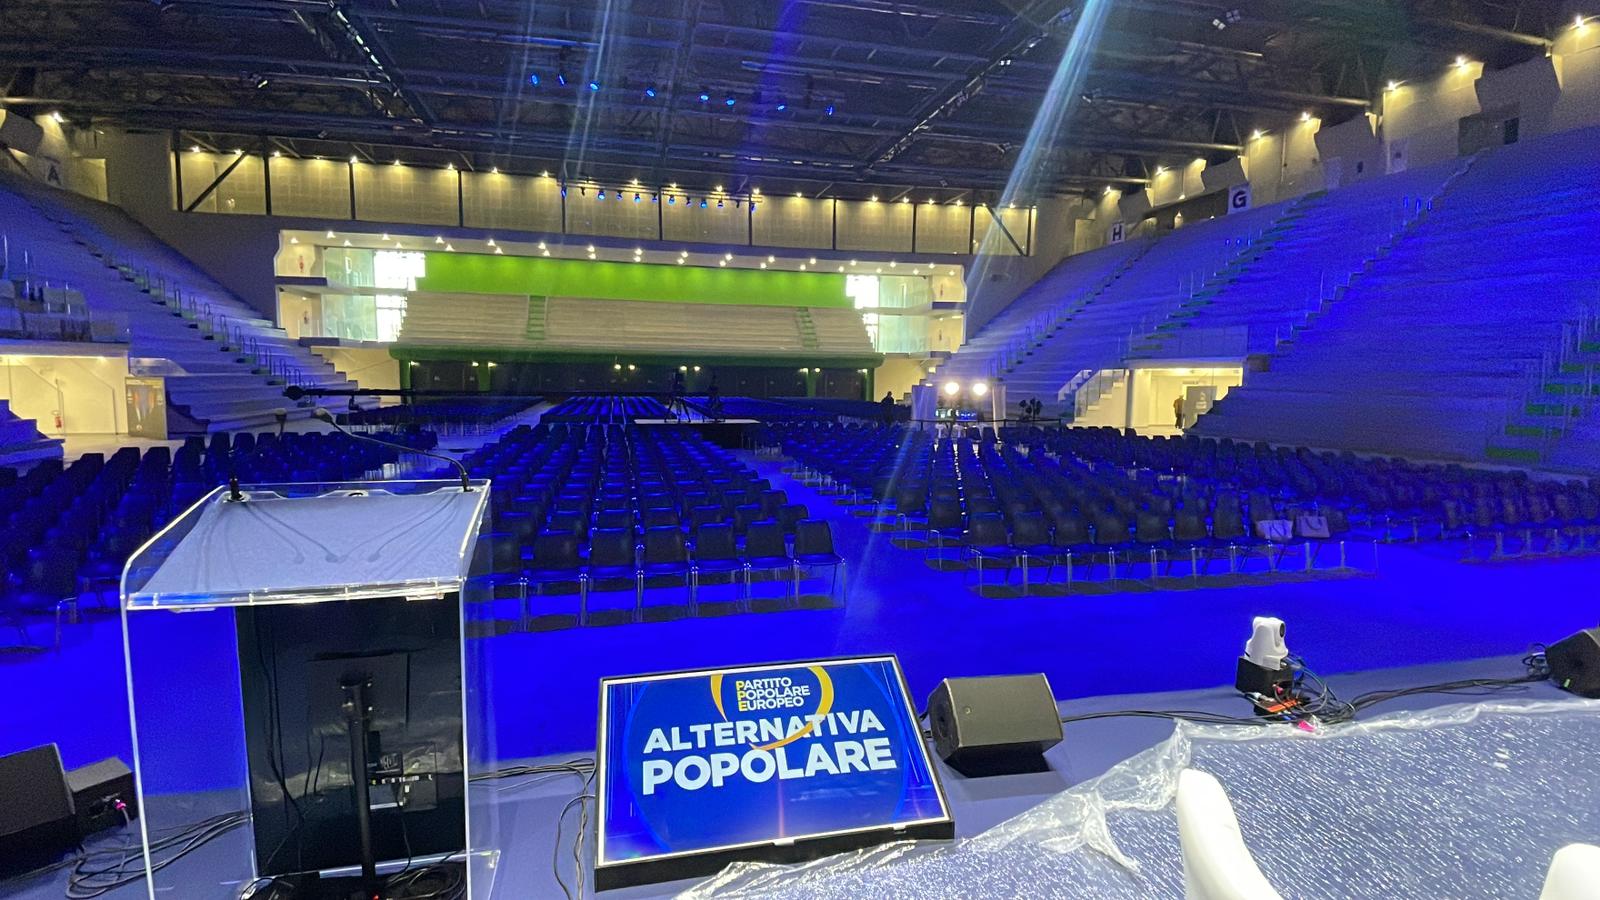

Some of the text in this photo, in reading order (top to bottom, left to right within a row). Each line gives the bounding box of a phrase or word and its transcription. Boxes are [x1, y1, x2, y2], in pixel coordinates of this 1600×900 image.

[1232, 190, 1248, 208] G
[1112, 225, 1122, 241] H
[736, 677, 792, 691] PARTITO
[737, 685, 810, 701] POPOLARE
[738, 696, 804, 711] EUROPEO
[643, 709, 886, 754] ALTERNATIVA
[642, 737, 897, 795] POPOLARE
